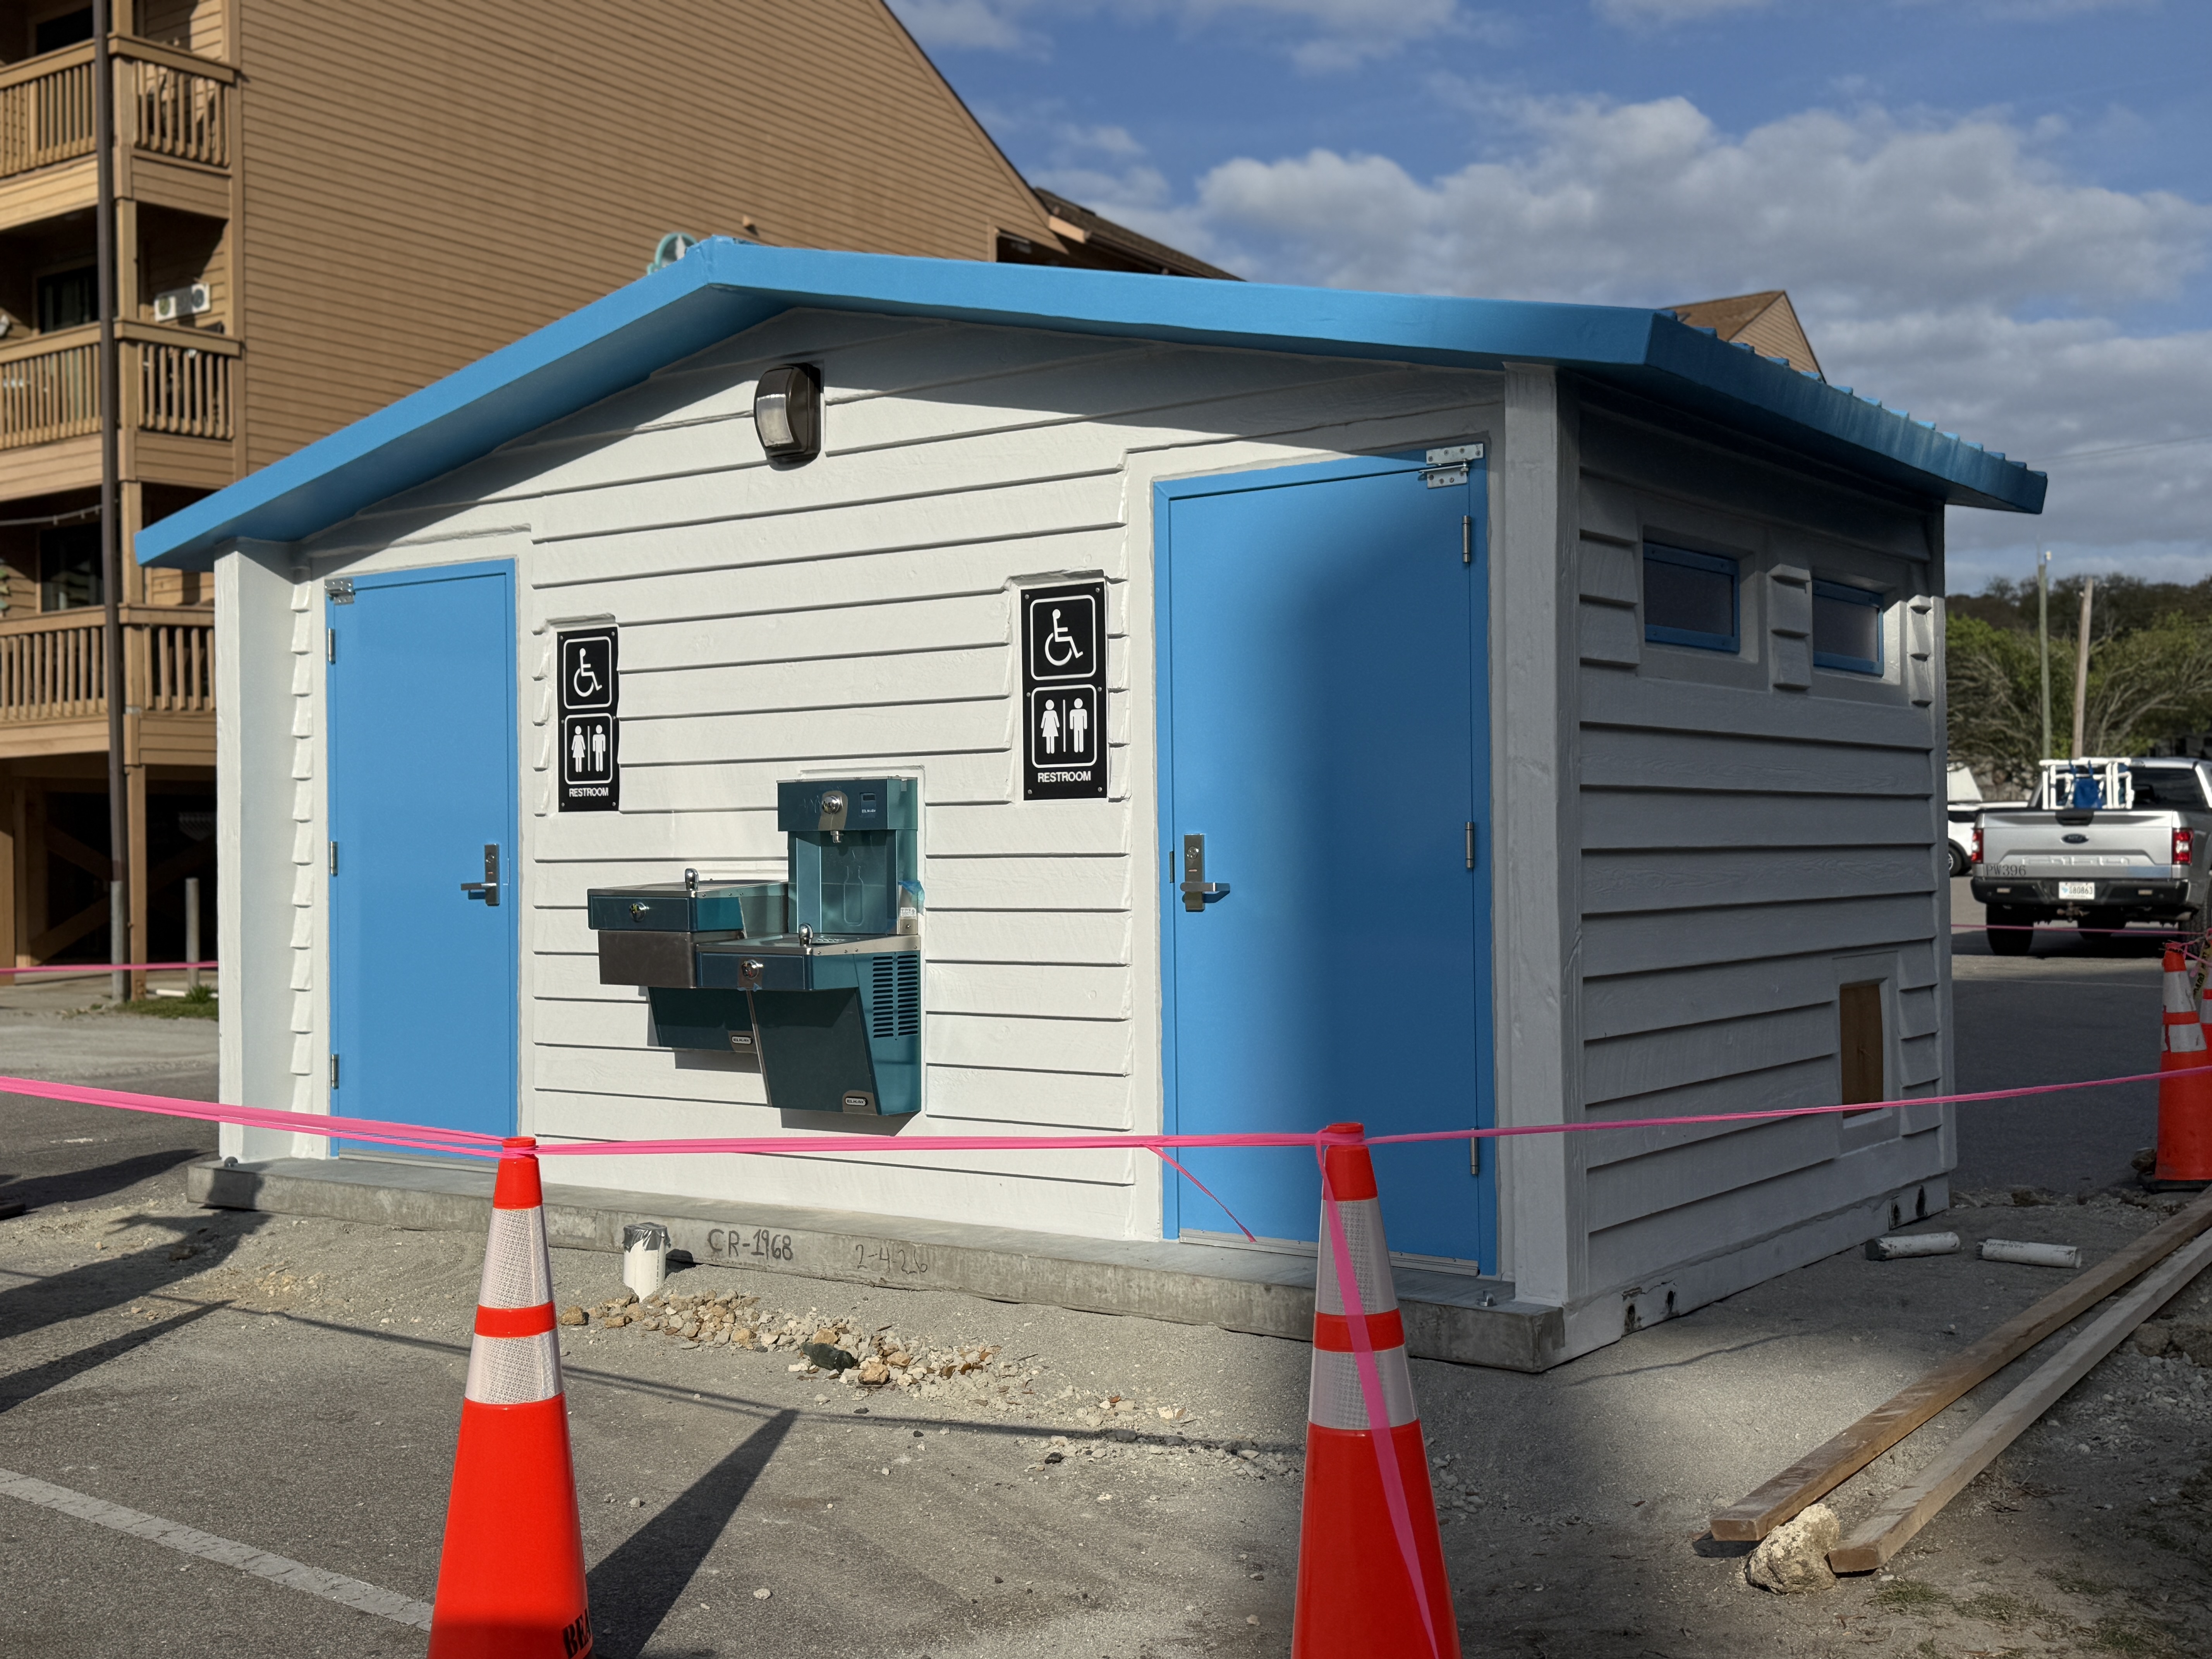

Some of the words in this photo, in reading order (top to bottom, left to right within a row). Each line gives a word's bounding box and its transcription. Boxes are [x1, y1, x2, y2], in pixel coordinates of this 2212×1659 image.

[1038, 771, 1091, 783] RESTROOM
[569, 787, 608, 797] RESTROOM
[1986, 864, 2026, 876] PW396
[708, 1229, 793, 1261] CR-1968
